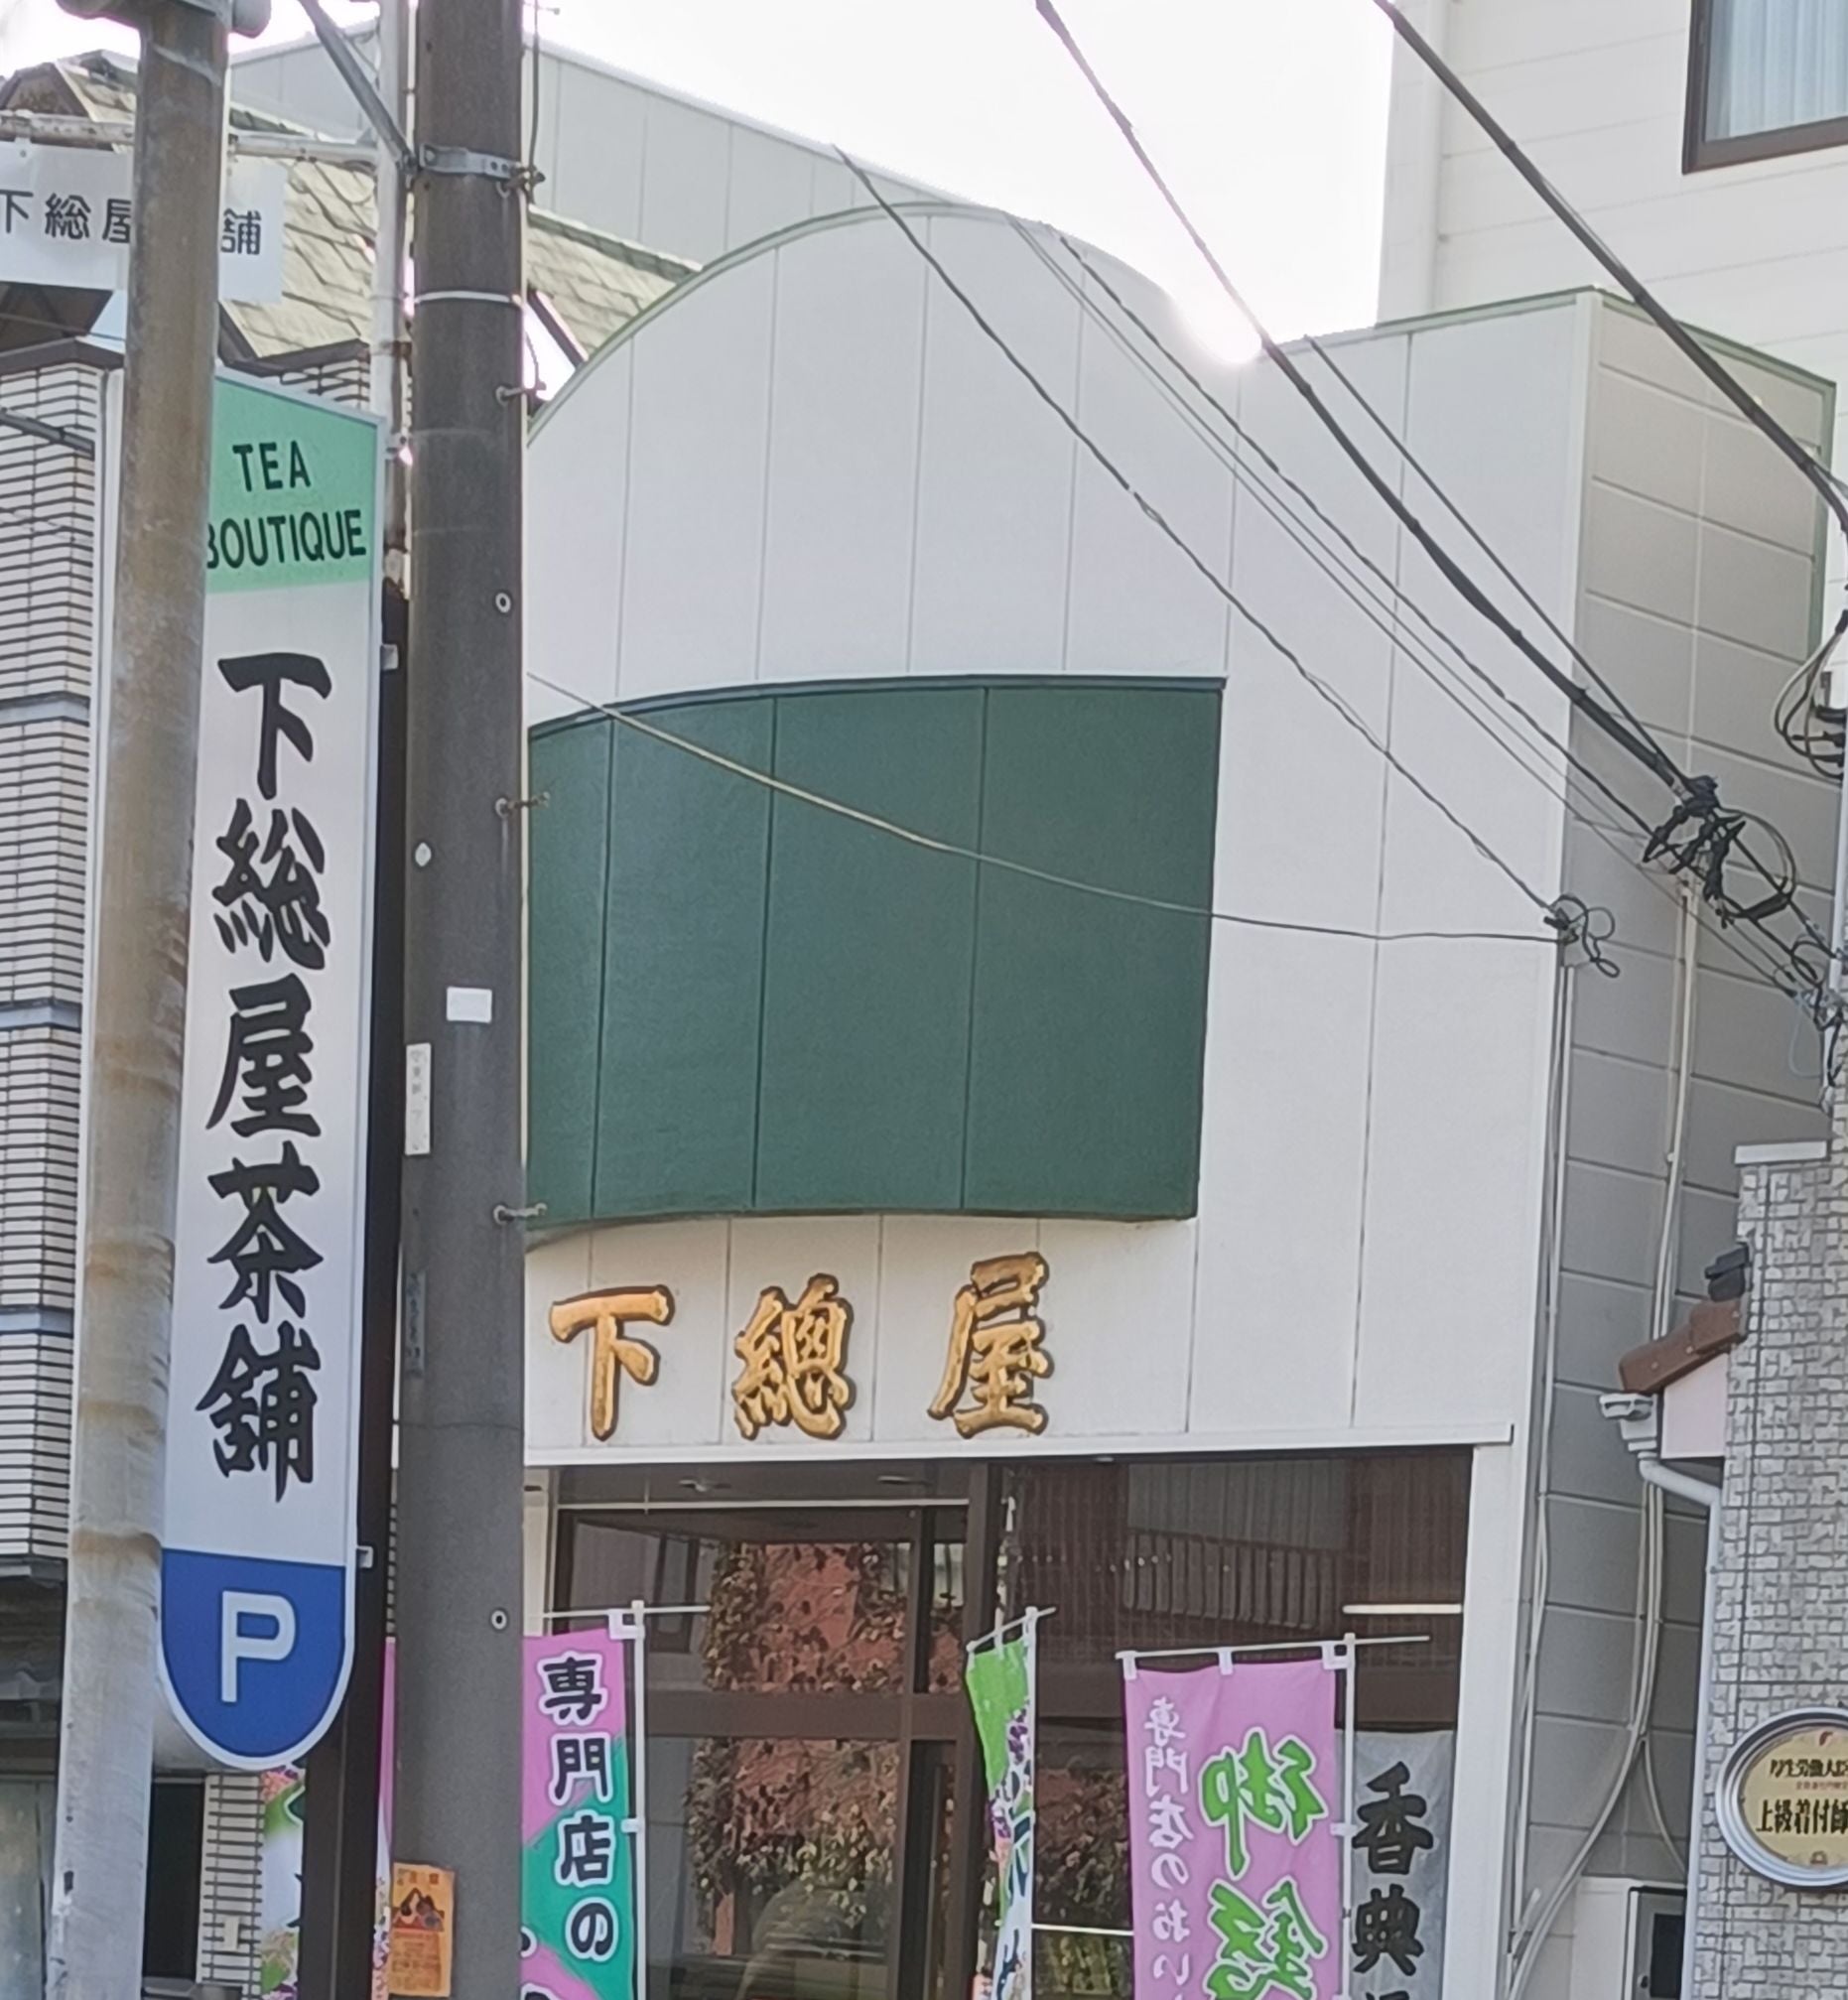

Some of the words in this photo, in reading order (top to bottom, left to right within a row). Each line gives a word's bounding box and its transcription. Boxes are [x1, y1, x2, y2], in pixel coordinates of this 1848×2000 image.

[0, 189, 261, 255] 下総屋舗
[232, 441, 311, 492] TEA
[195, 651, 332, 1504] 下総屋茶舗
[221, 1590, 296, 1703] P
[536, 1651, 619, 1962] 専門店の
[1351, 1760, 1435, 2000] 香典
